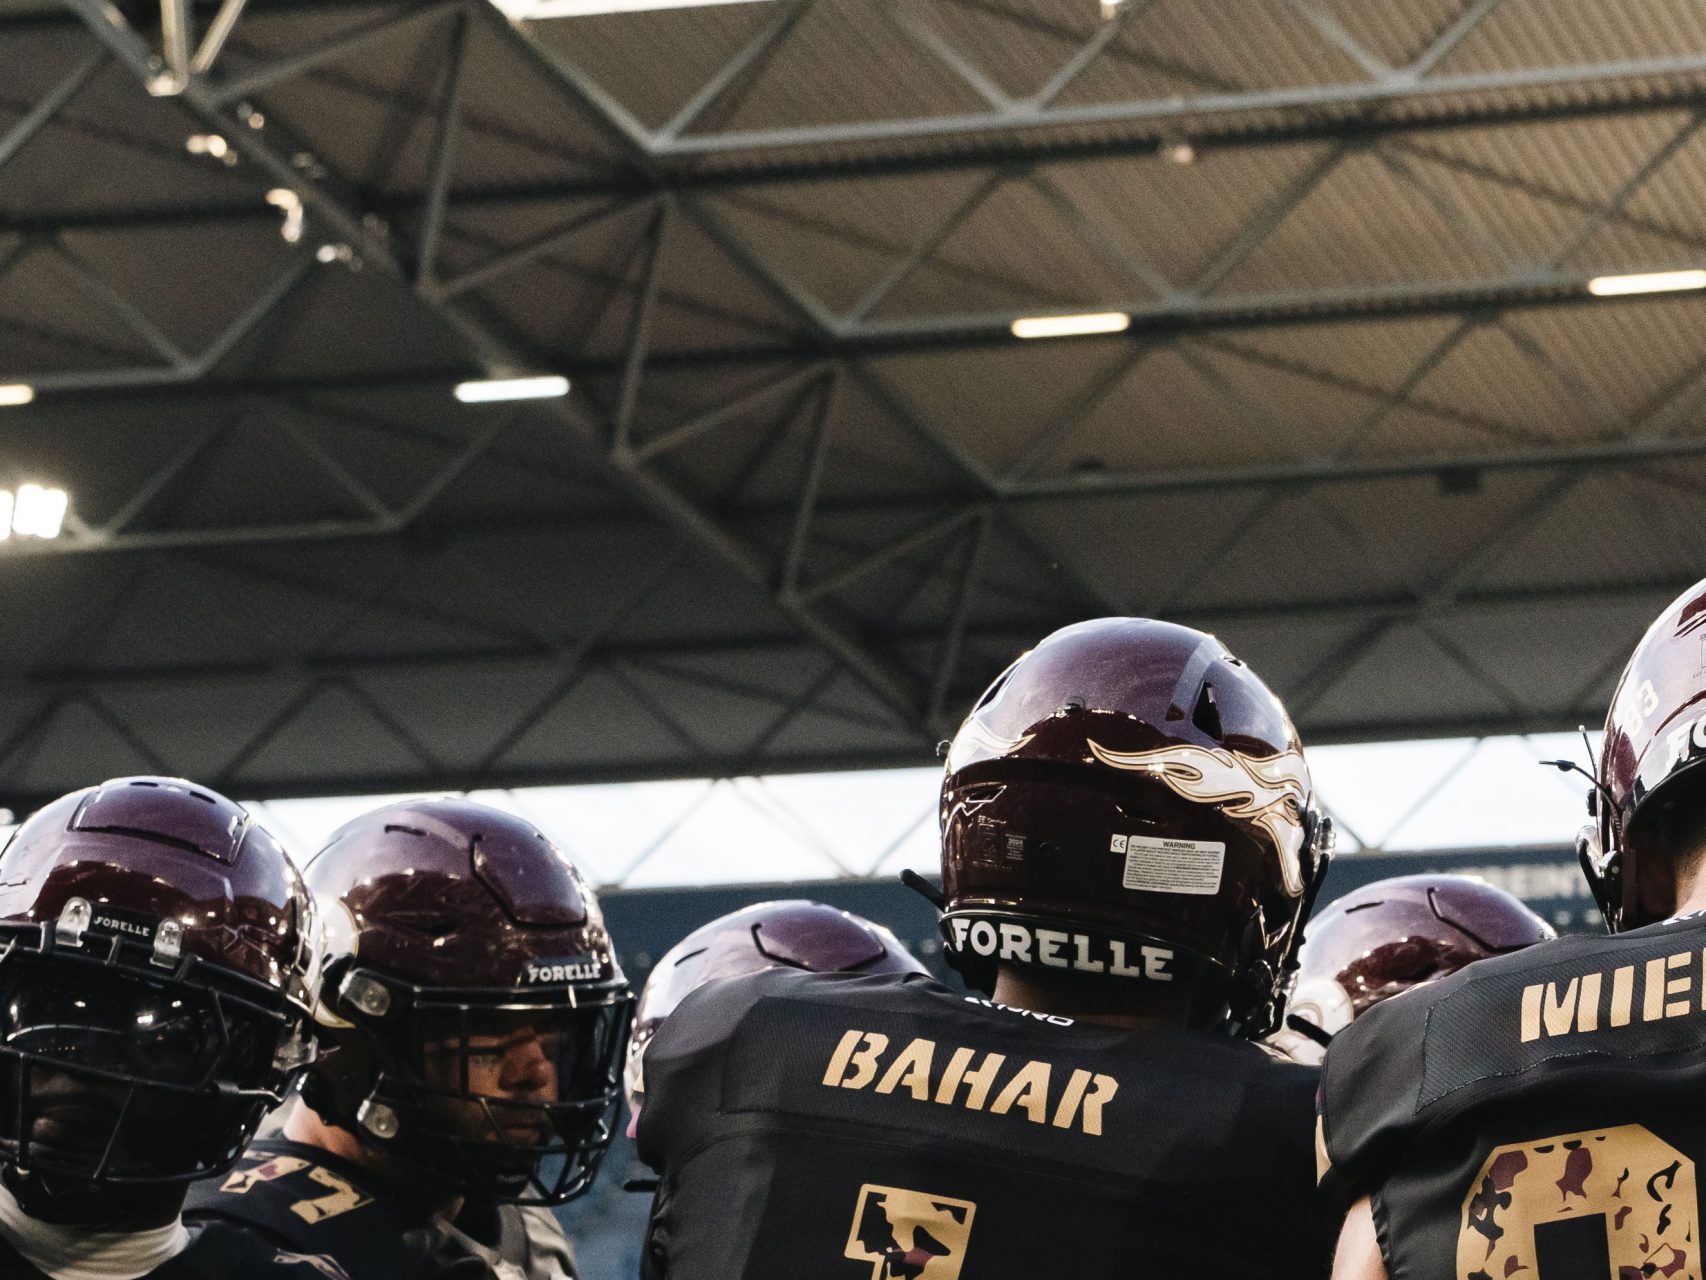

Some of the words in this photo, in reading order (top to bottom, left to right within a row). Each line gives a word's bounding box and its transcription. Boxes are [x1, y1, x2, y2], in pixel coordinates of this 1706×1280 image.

[1163, 841, 1196, 850] WARNING
[94, 916, 150, 937] FORELLE
[951, 918, 1174, 981] FORELLE
[528, 964, 601, 983] FORELLE
[1521, 947, 1706, 1043] MIE
[821, 1030, 1119, 1135] BAHAR
